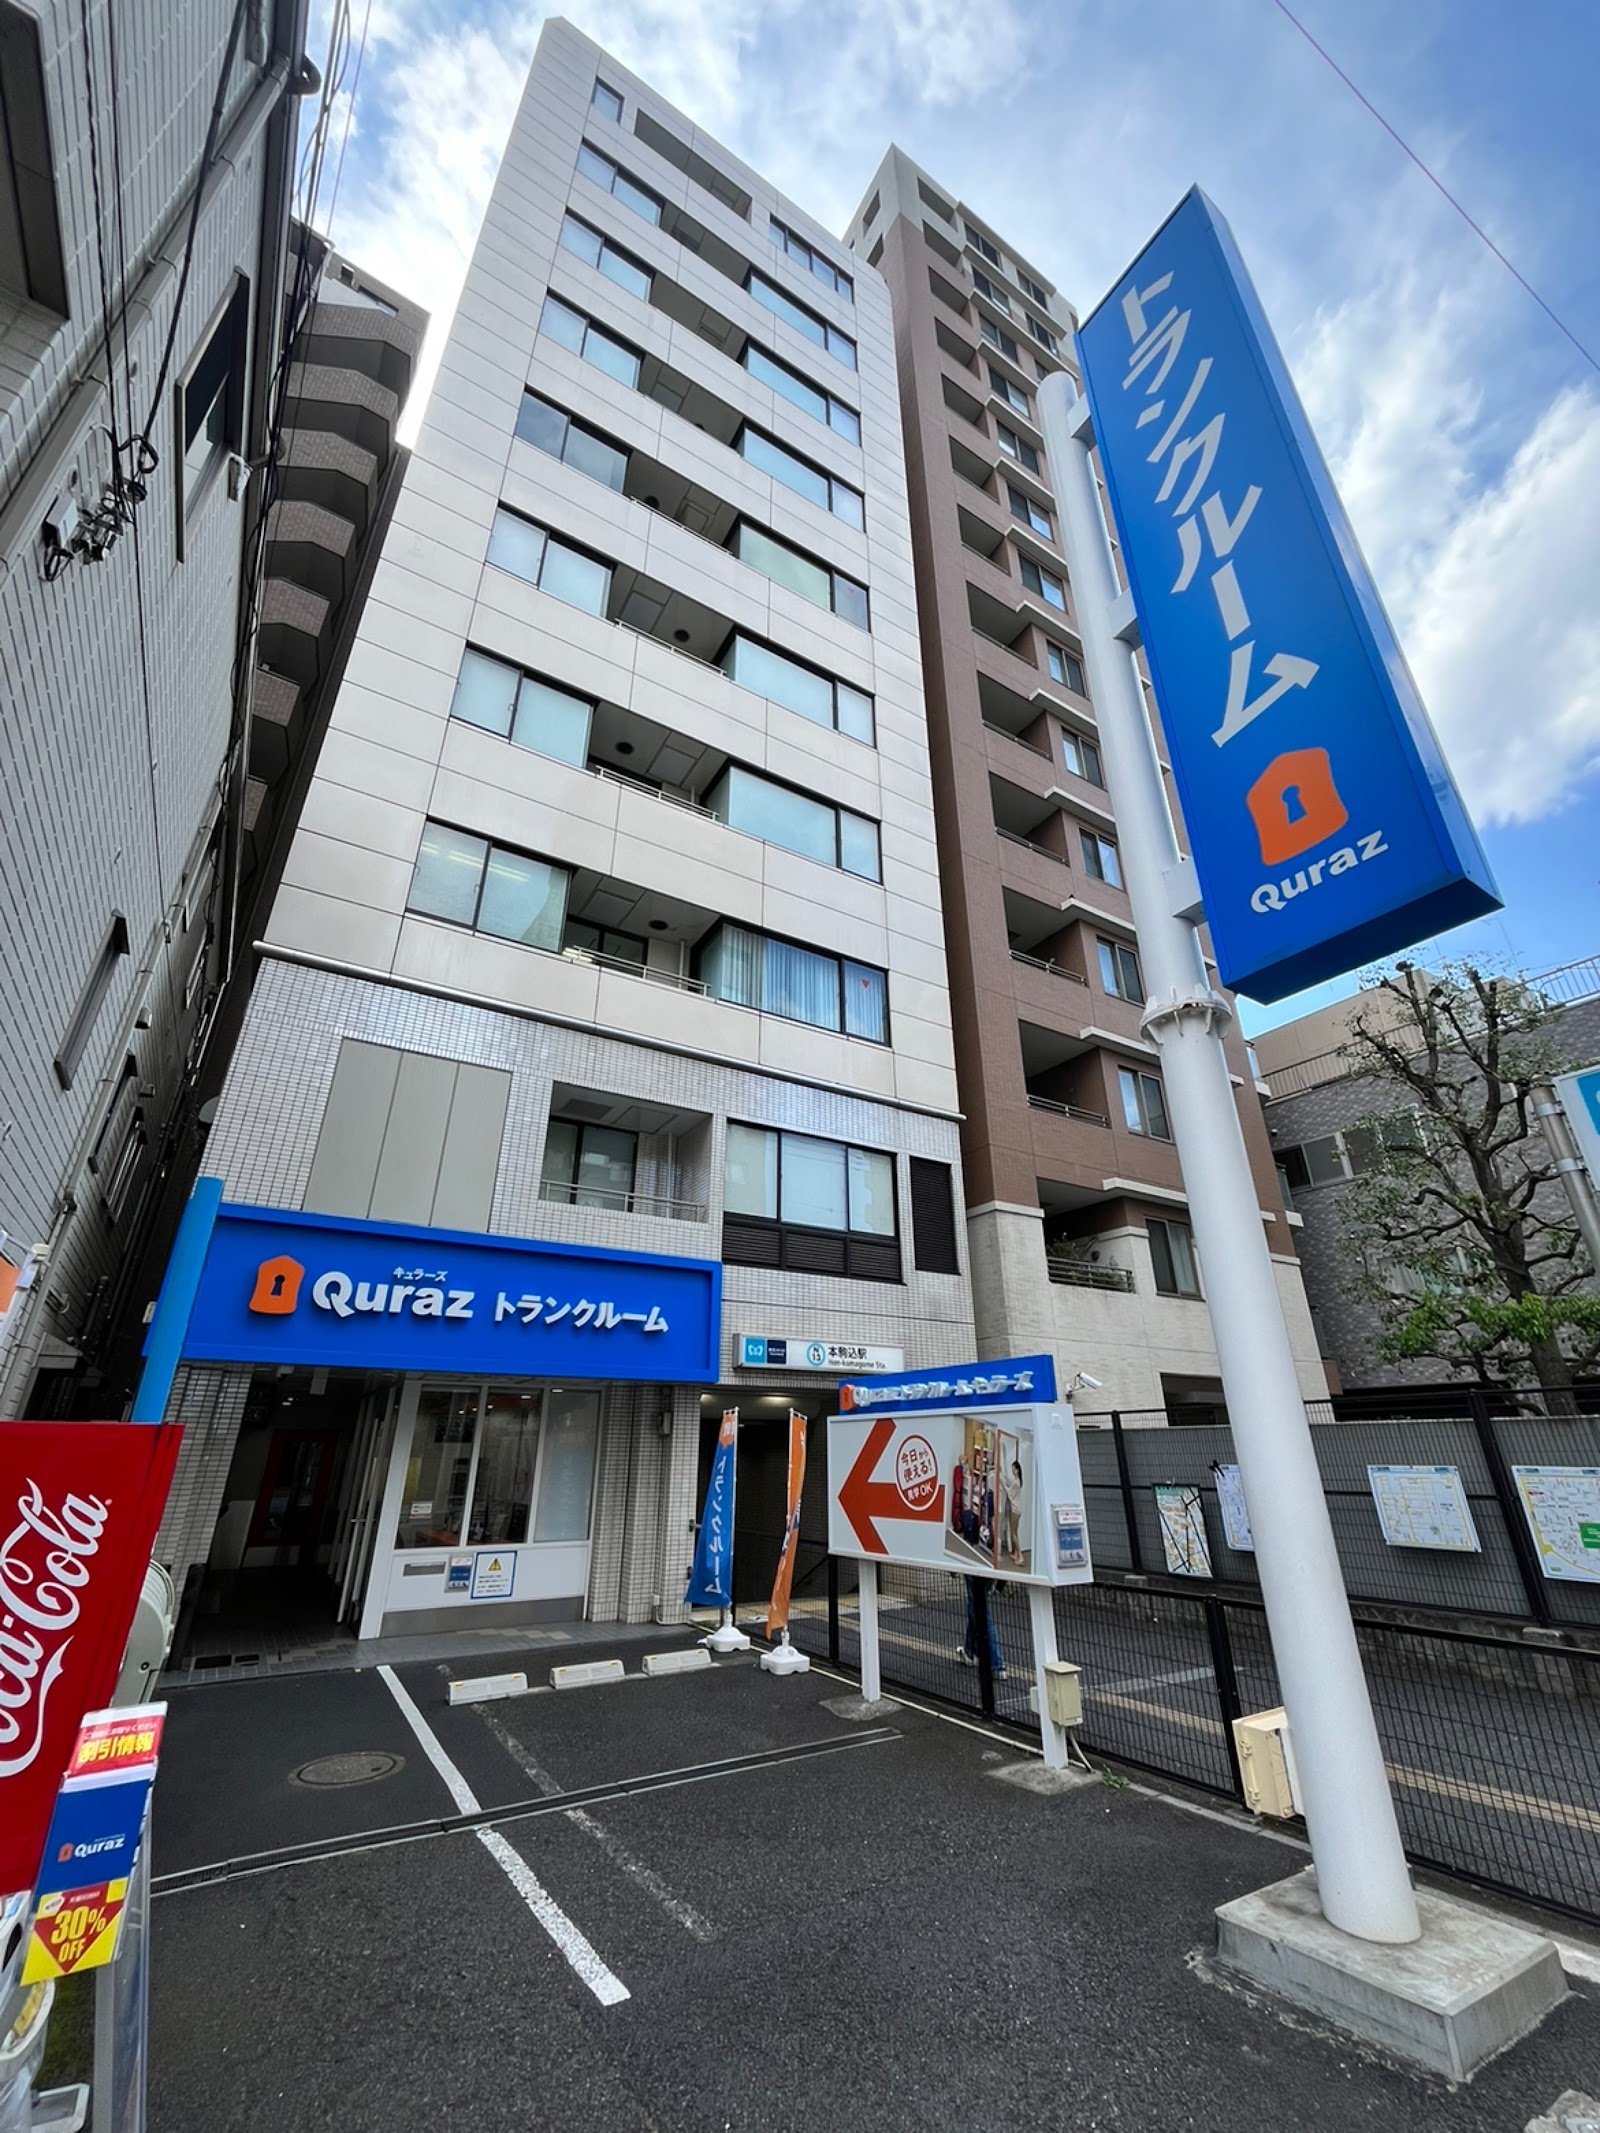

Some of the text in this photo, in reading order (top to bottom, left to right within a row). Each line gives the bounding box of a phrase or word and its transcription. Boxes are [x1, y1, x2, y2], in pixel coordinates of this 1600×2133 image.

[1121, 271, 1320, 749] トランクルーム
[1250, 829, 1389, 913] Quraz
[392, 1266, 449, 1283] キュラーズ
[312, 1270, 670, 1334] Quraz トランクルーム
[811, 1352, 822, 1362] 13
[828, 1345, 868, 1360] 本駒込駅
[828, 1359, 875, 1369] Hon-komagome
[78, 1731, 155, 1765] 割引情報
[74, 1836, 126, 1859] Quraz
[50, 1905, 107, 1945] 30%
[58, 1938, 87, 1964] OFF
